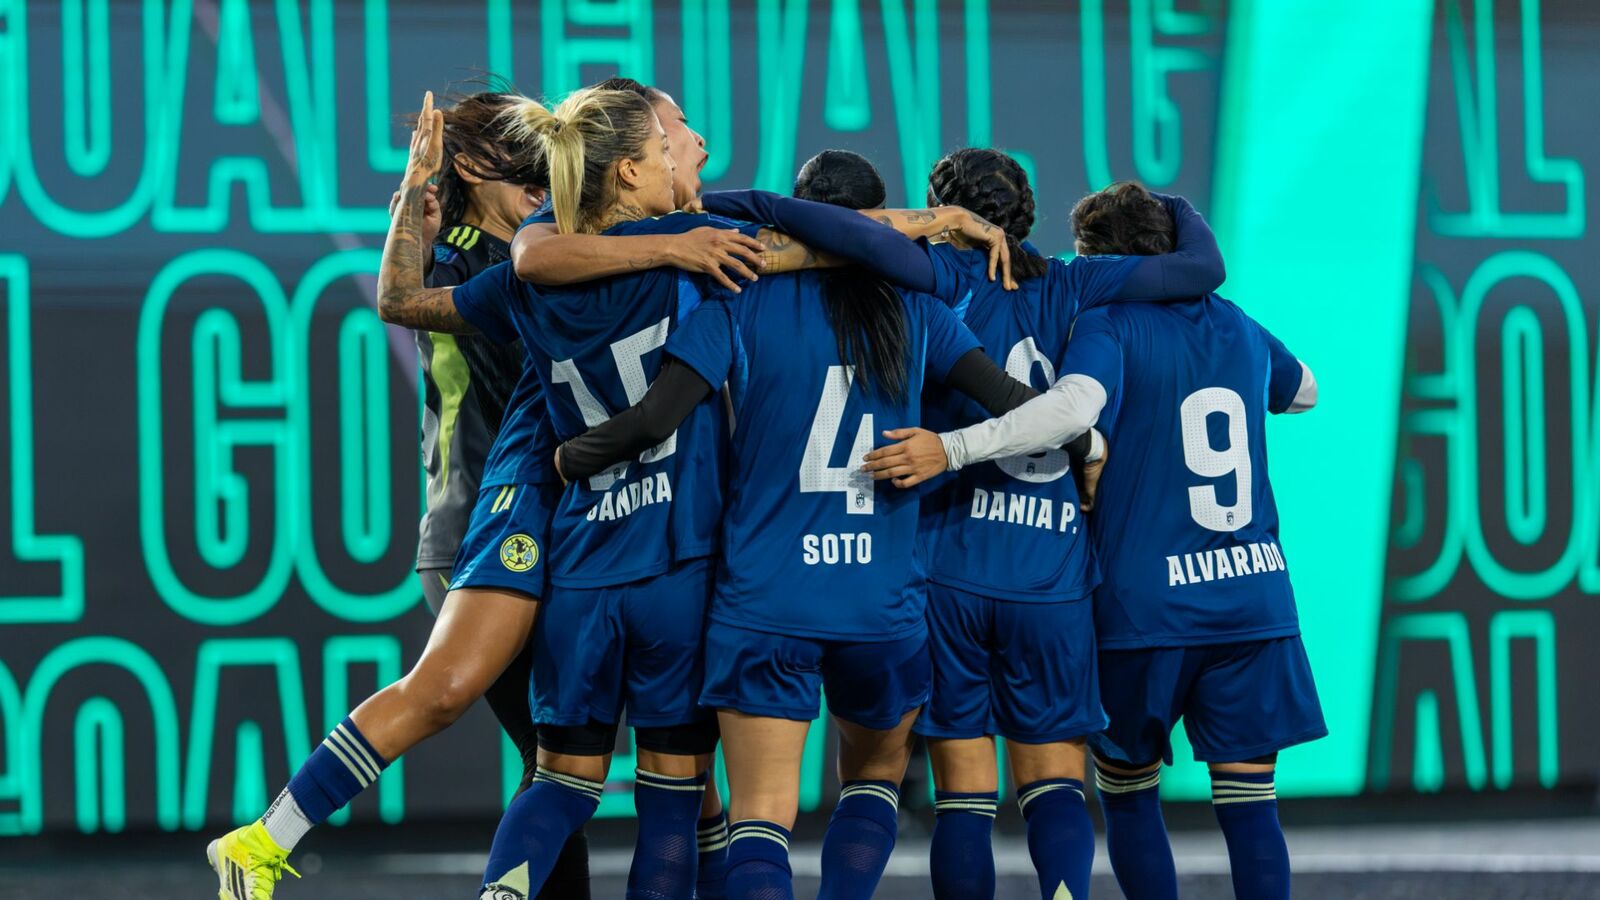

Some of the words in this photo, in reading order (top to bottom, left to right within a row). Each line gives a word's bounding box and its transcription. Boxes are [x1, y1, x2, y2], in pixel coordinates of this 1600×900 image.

[799, 365, 874, 515] 4
[1180, 387, 1252, 532] 9
[970, 487, 1053, 530] DANIA
[1059, 501, 1078, 535] P.
[803, 532, 872, 565] SOTO
[1166, 542, 1285, 587] ALVARADO
